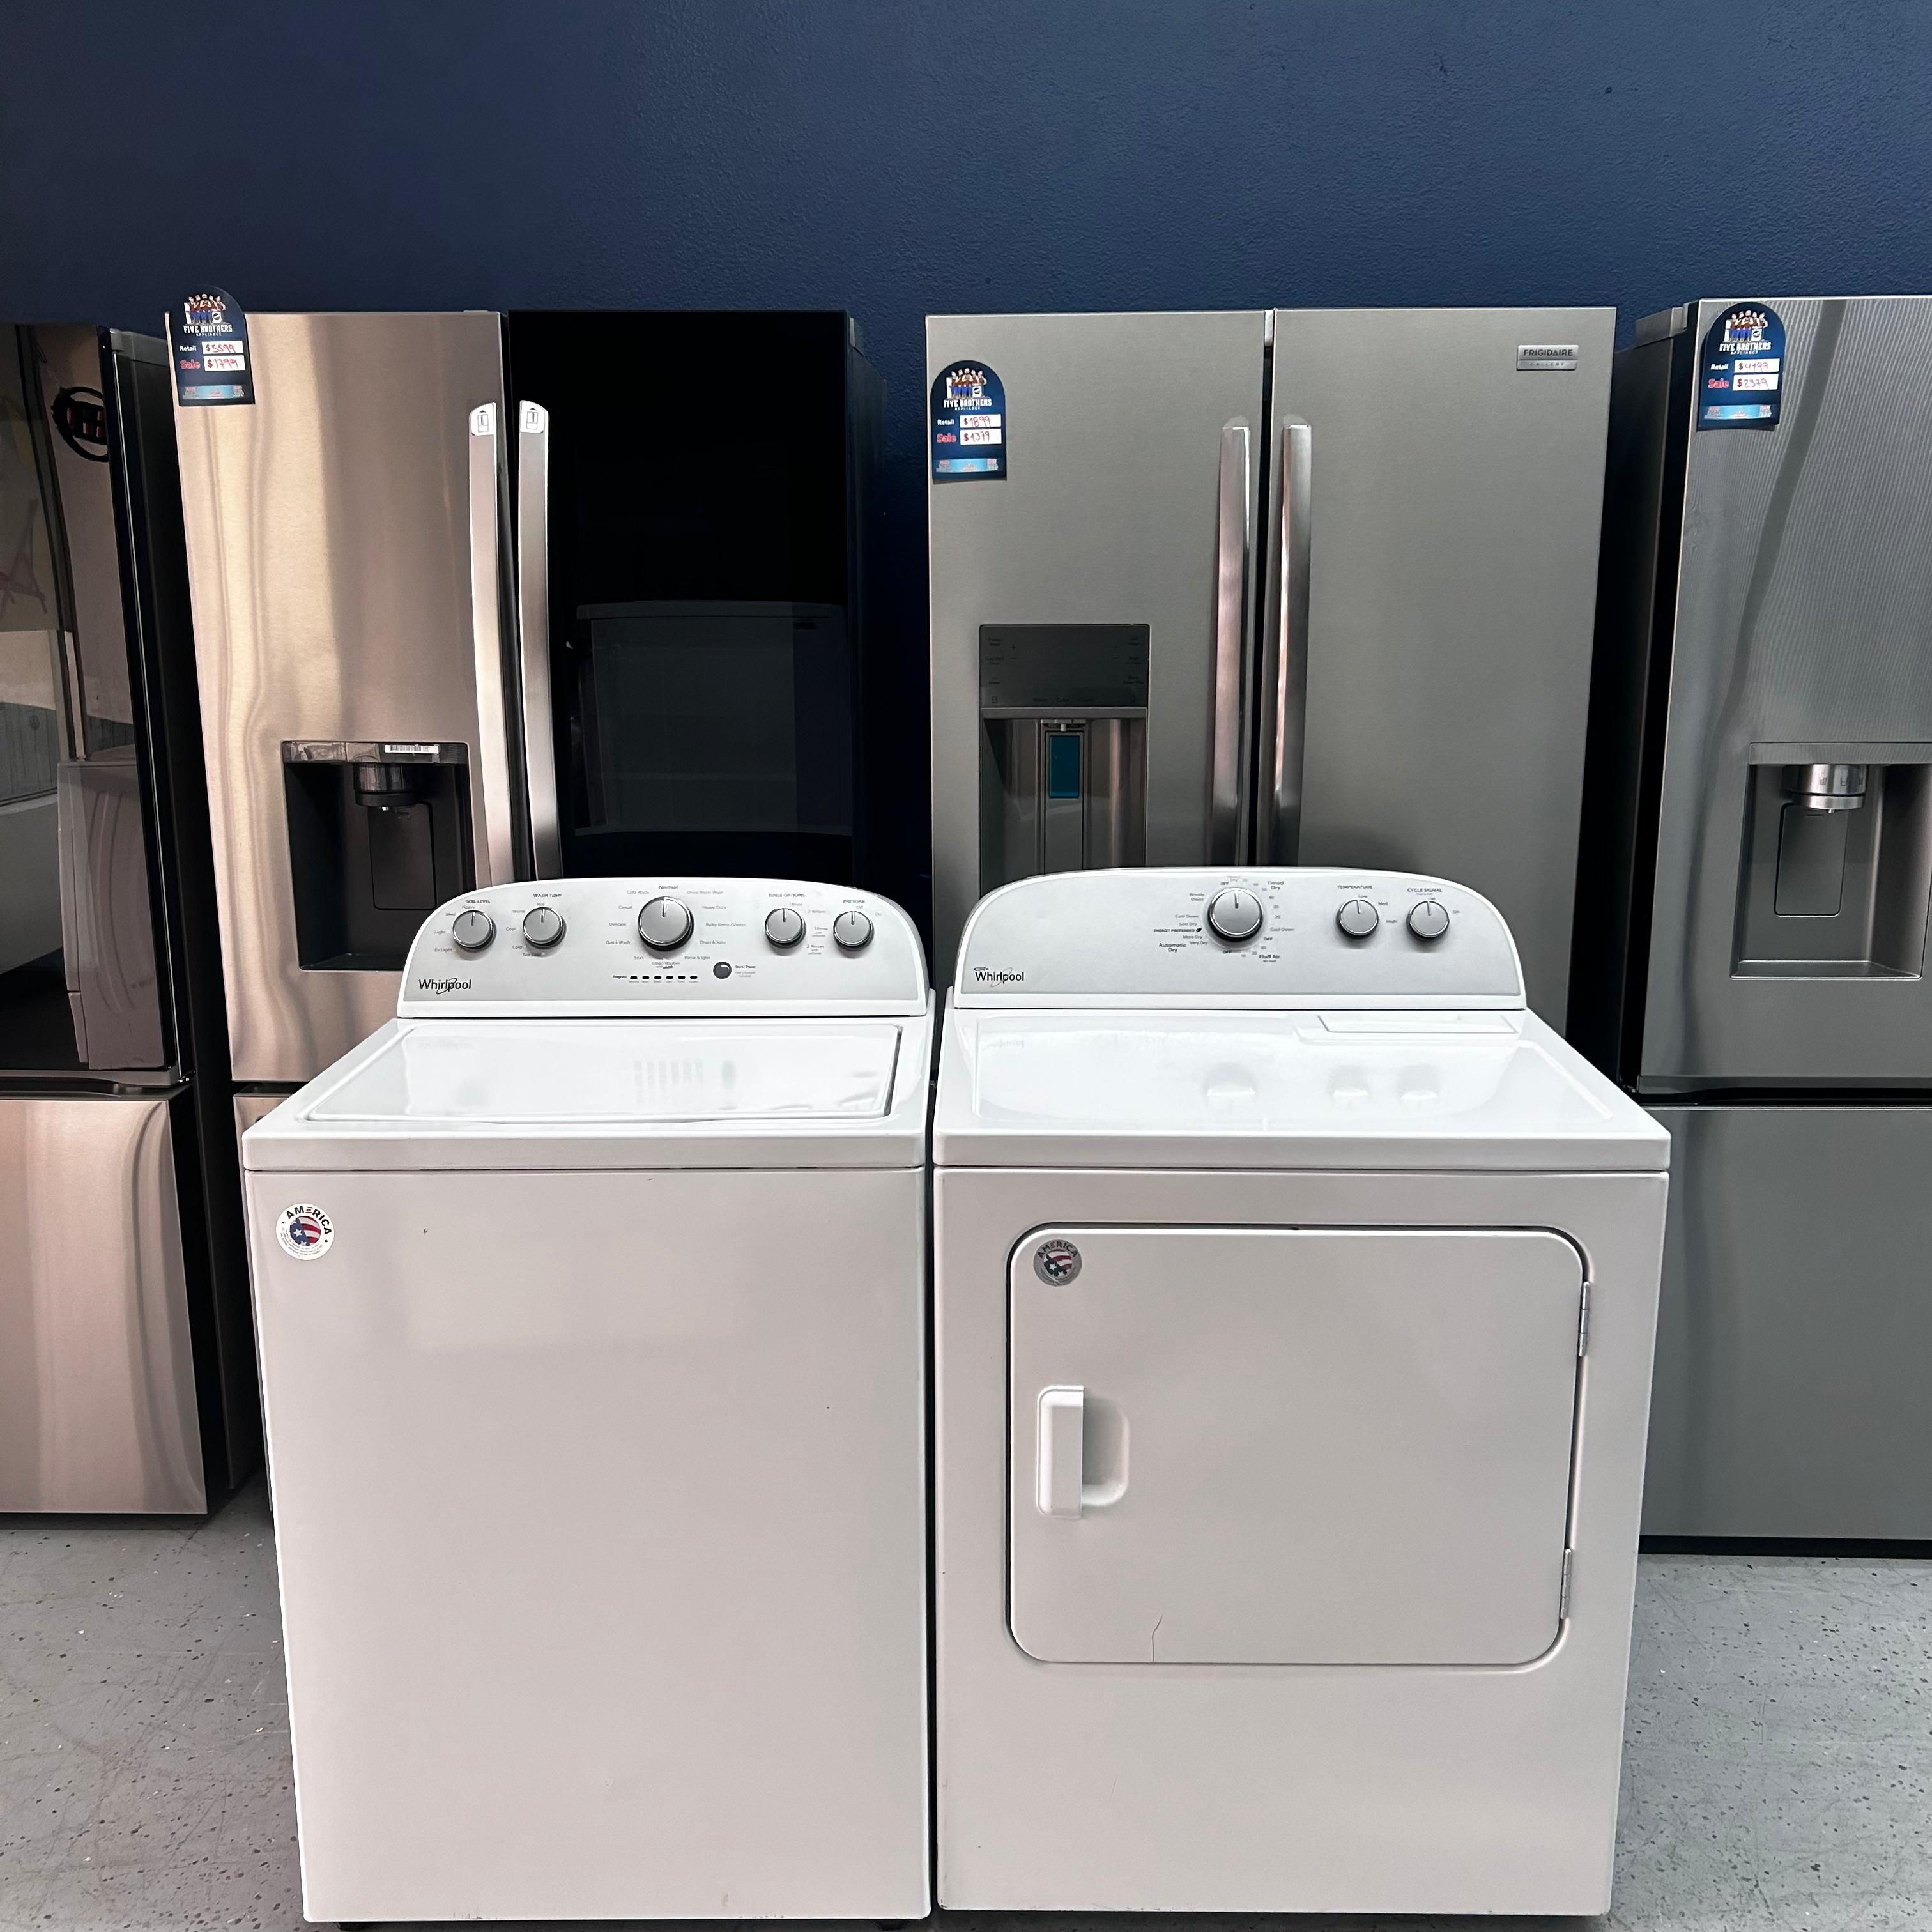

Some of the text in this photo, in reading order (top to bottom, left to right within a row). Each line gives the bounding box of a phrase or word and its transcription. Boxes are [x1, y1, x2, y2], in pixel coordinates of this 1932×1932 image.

[183, 325, 233, 334] FIVE BROTHERS
[1719, 342, 1771, 351] FIVE BROTHERS
[180, 359, 201, 369] Sale
[1708, 378, 1729, 388] Sale
[944, 399, 992, 408] FIVE BROTHERS
[937, 433, 957, 443] Sale
[976, 972, 1024, 984] Whirlpool
[418, 979, 471, 993] Whirlpool
[286, 1206, 332, 1235] AMERICA
[1038, 1241, 1078, 1259] AMERICA
